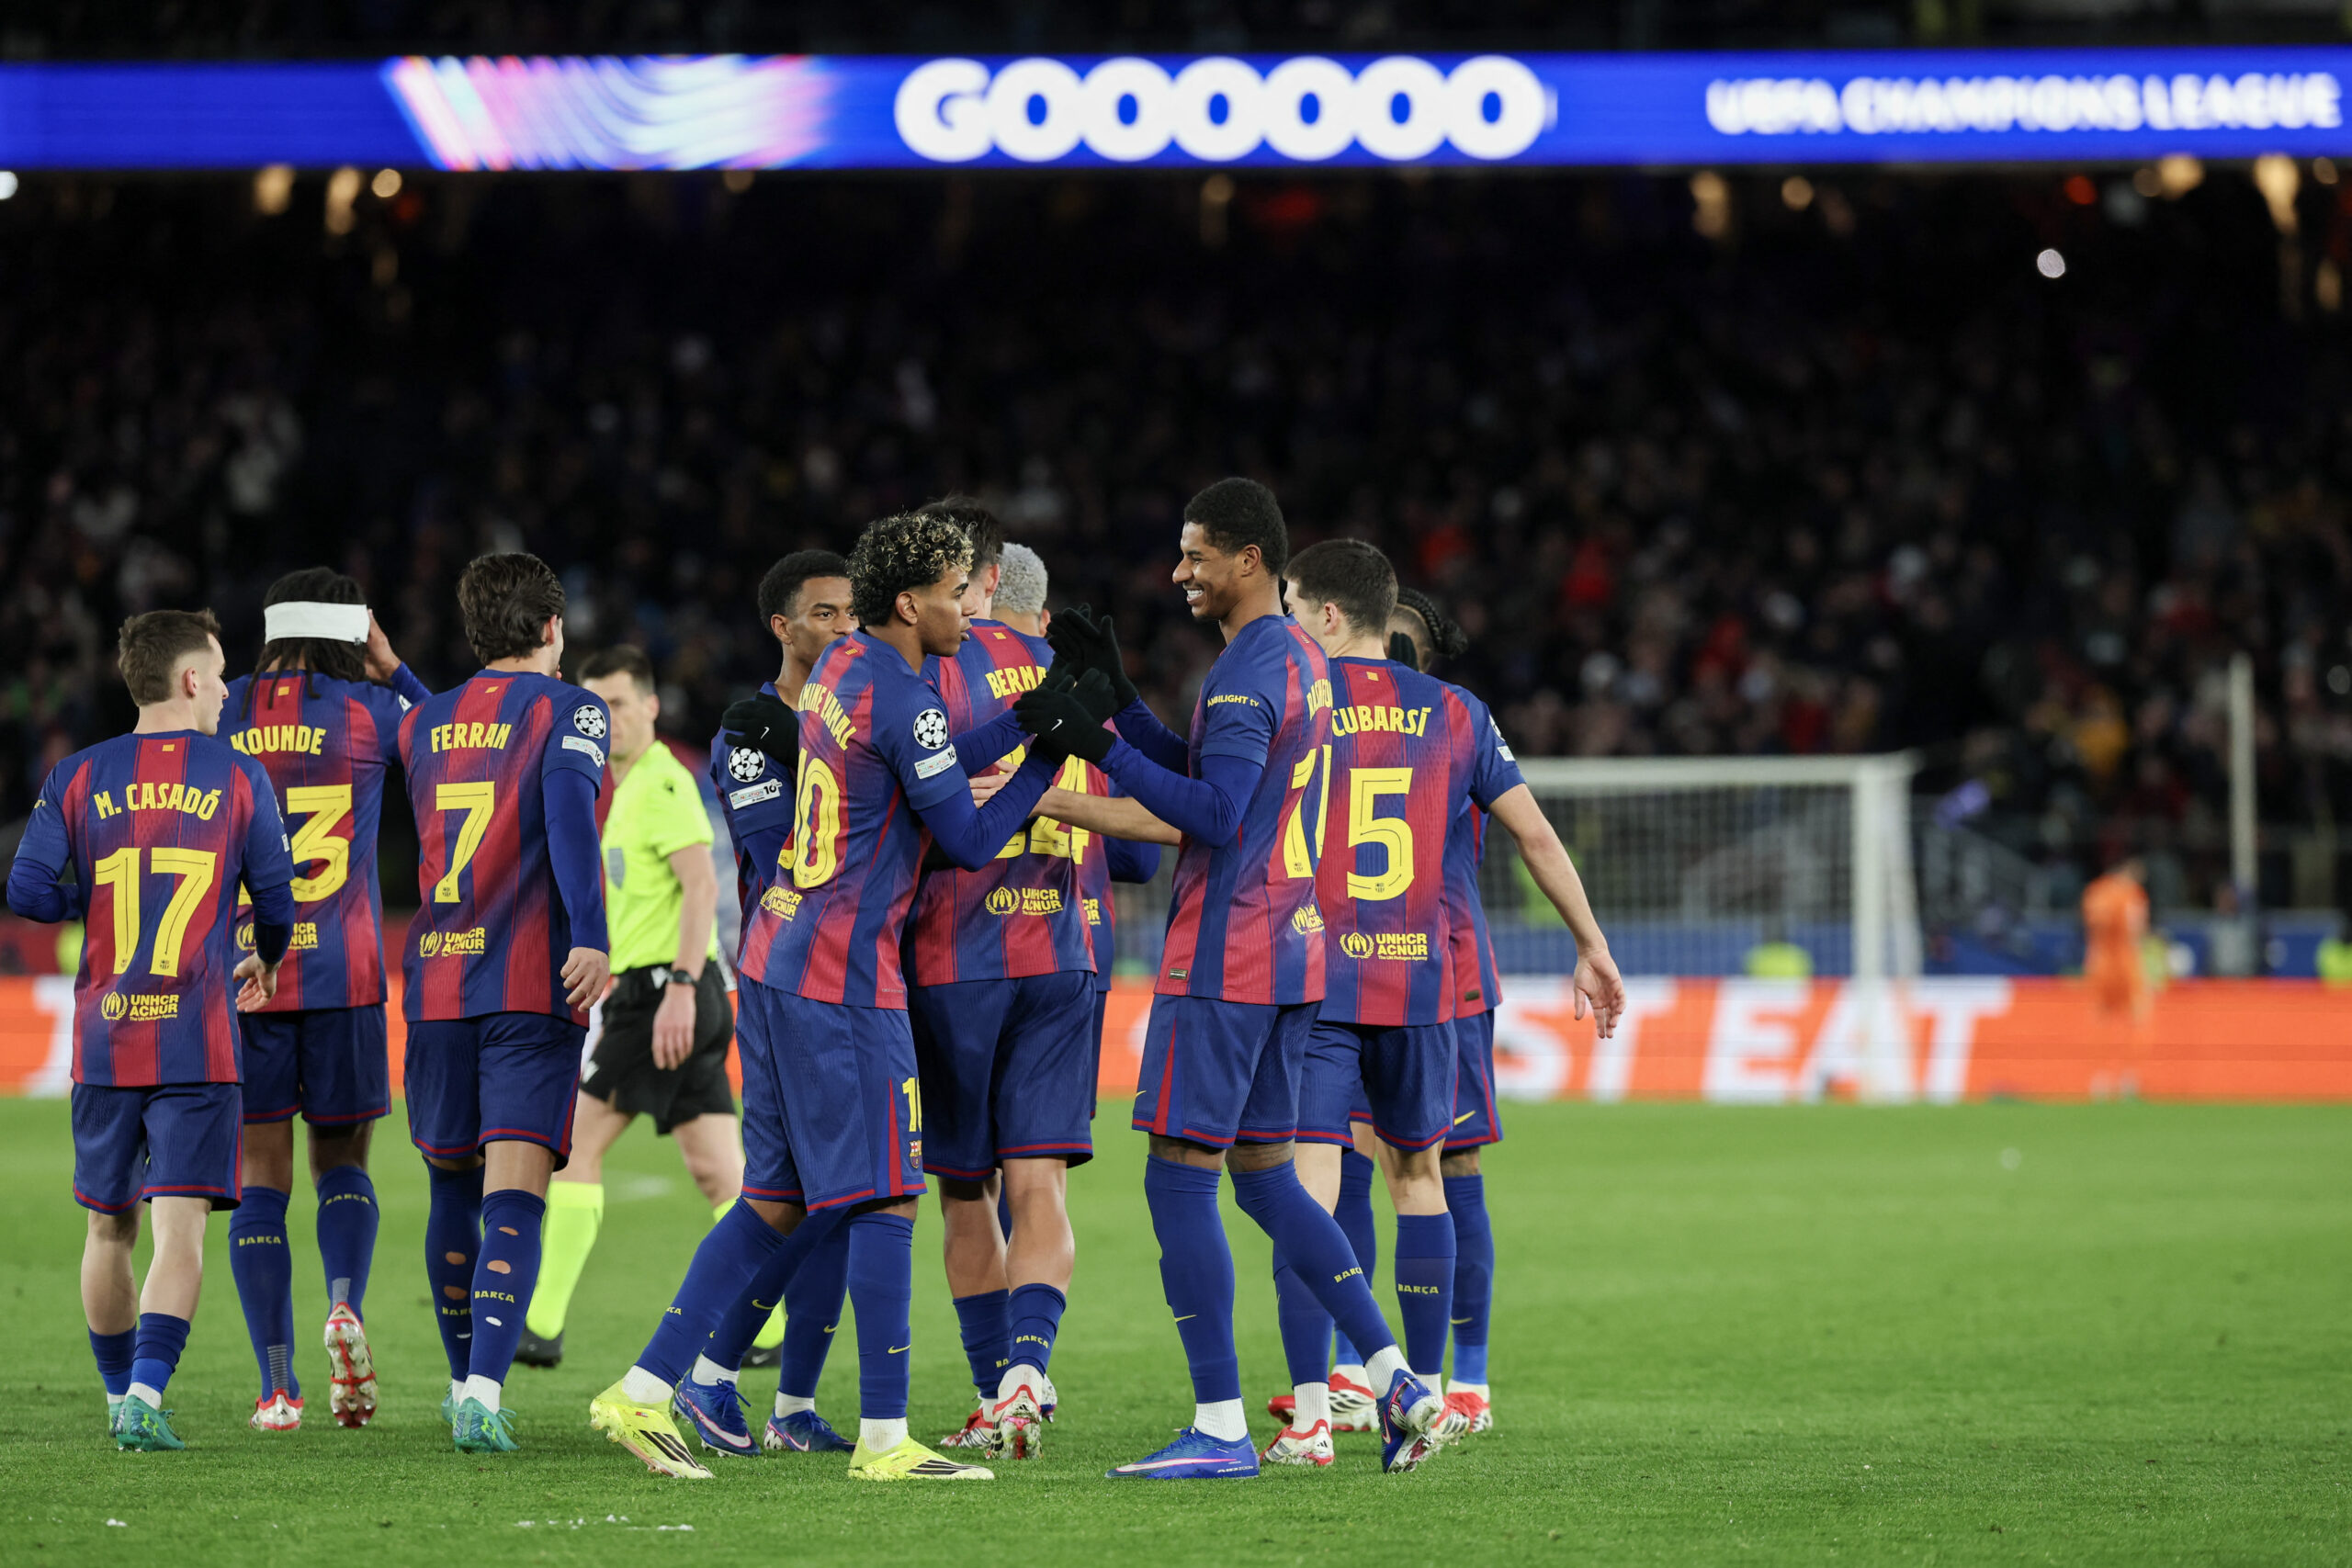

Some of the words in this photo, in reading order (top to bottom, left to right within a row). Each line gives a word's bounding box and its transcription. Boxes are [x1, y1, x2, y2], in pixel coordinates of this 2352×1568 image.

[431, 722, 512, 753] FERRAN
[1332, 705, 1431, 738] CUBARSÍ
[94, 791, 122, 819] M.
[126, 783, 222, 820] CASADÓ
[435, 781, 495, 902] 7
[1347, 767, 1415, 901] 5
[96, 847, 217, 977] 17
[1375, 933, 1428, 944] UNHCR
[1377, 944, 1428, 955] ACNUR
[129, 1003, 178, 1017] ACNUR
[130, 994, 179, 1006] UNHCR
[1494, 976, 1679, 1100] ST
[1701, 975, 2013, 1102] EAT
